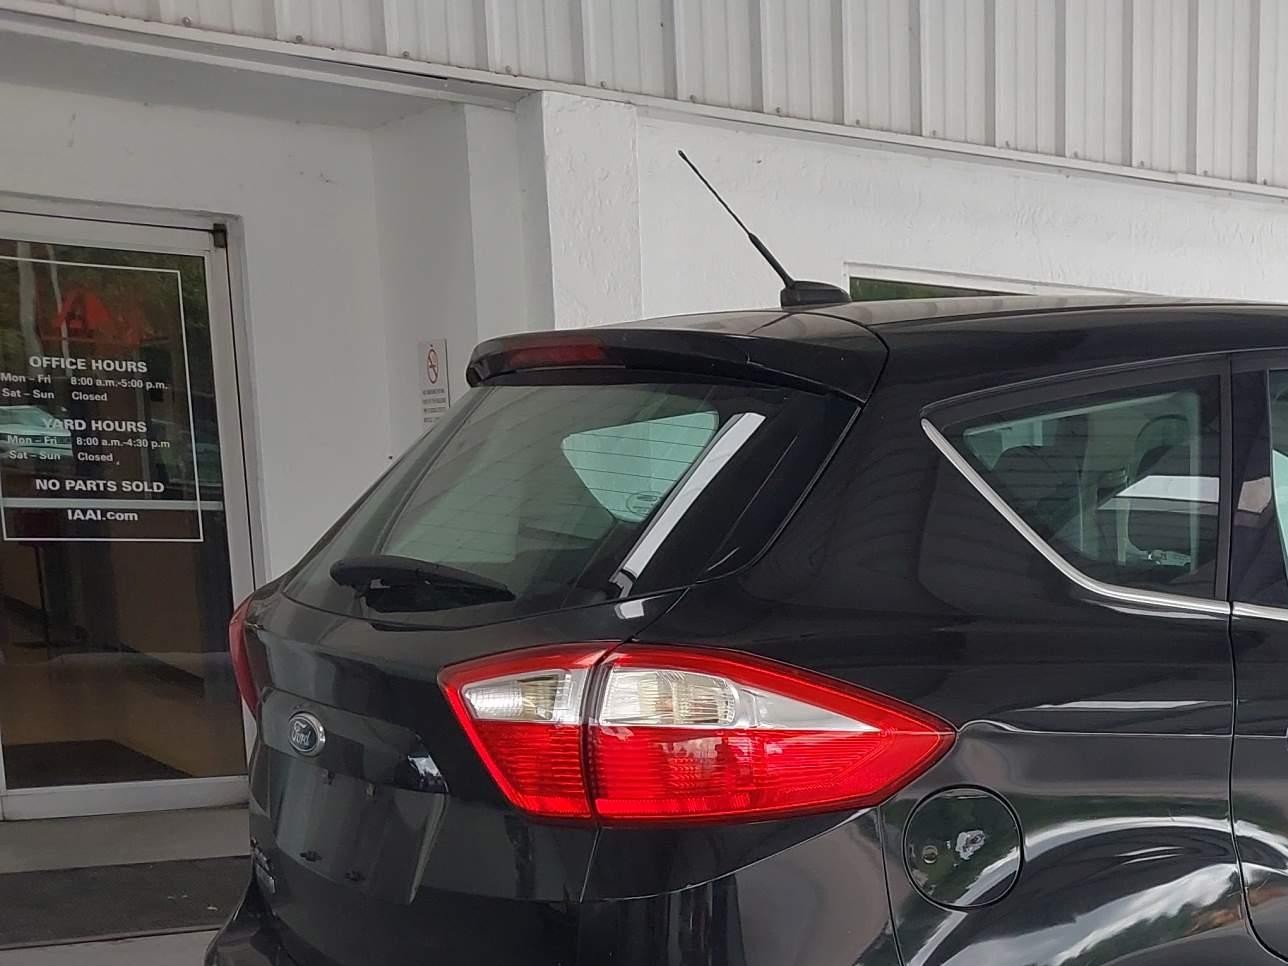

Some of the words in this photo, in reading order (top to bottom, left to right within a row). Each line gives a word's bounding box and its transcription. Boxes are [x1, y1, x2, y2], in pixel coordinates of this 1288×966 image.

[29, 356, 87, 370] OFFICE
[92, 359, 148, 373] HOURS
[0, 373, 26, 383] Mon
[38, 374, 51, 384] Fri
[70, 376, 93, 386] 8:00
[96, 378, 143, 389] a.m.-5:00
[146, 381, 168, 390] p.m.
[2, 388, 22, 398] Sat
[32, 389, 55, 399] Sun
[71, 391, 108, 401] Closed
[42, 417, 86, 431] YARD
[91, 419, 148, 433] HOURS
[7, 435, 33, 445] Mon
[44, 436, 58, 445] Fri
[76, 436, 99, 446] 8:00
[101, 438, 148, 448] a.m.-4:30
[8, 450, 28, 460] Sat
[39, 450, 61, 460] Sun
[77, 452, 113, 462] Closed
[35, 478, 60, 490] NO
[65, 479, 117, 492] PARTS
[122, 480, 165, 493] SOLD
[67, 508, 138, 521] IAAI.com
